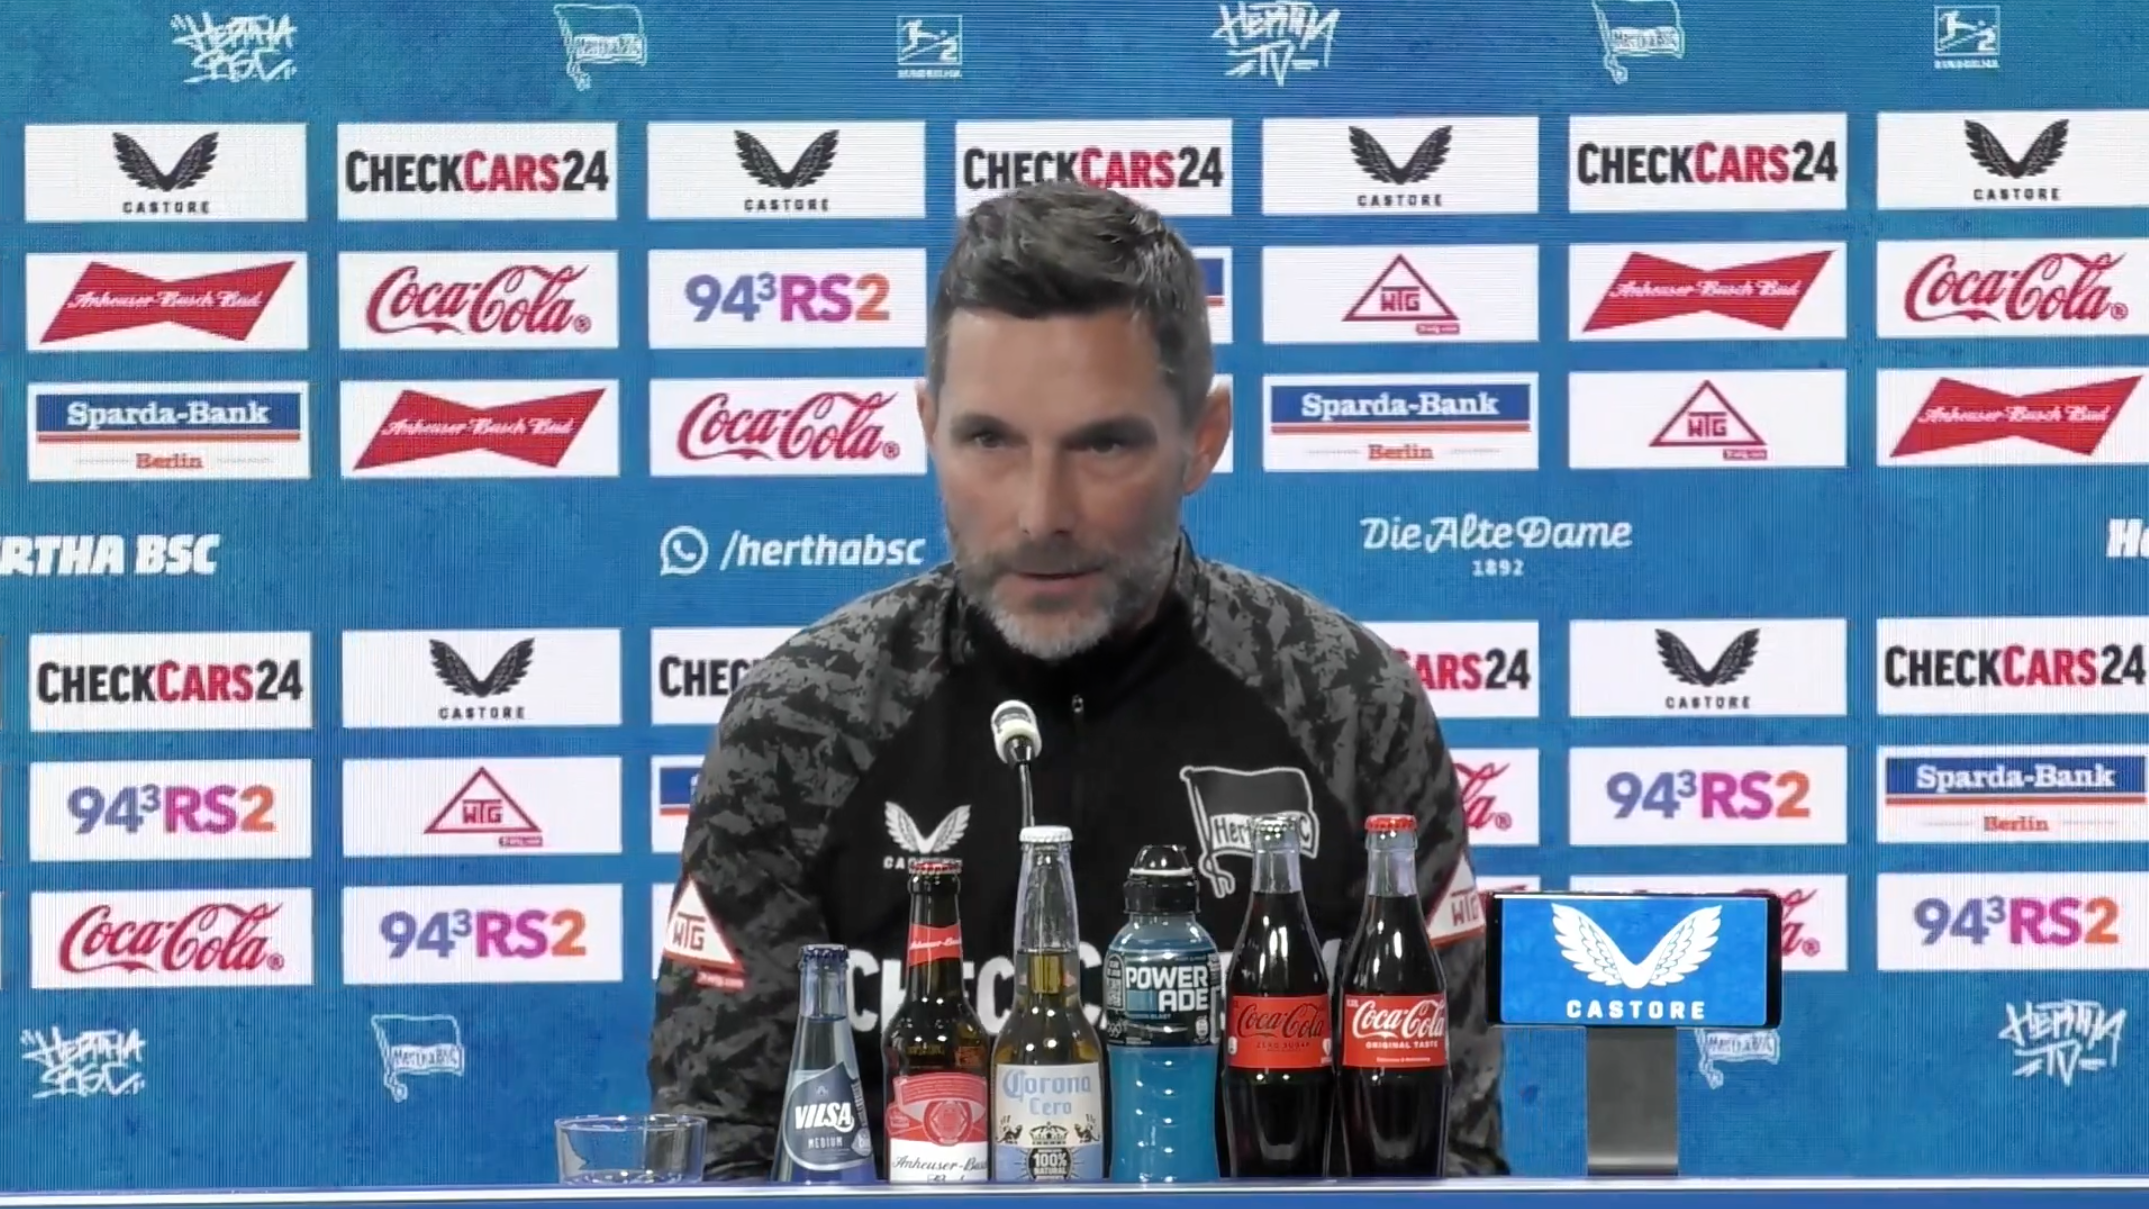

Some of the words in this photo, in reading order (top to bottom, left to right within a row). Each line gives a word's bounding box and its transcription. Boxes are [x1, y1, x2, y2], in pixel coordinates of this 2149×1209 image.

[346, 149, 609, 193] CHECKCARS24
[964, 146, 1223, 190] CHECKCARS24
[1578, 140, 1838, 185] CHECKCARS24
[744, 198, 829, 212] CASTORE
[1357, 193, 1442, 207] CASTORE
[1973, 187, 2060, 201] CASTORE
[122, 200, 209, 214] CASTORE
[1381, 286, 1420, 312] WTG
[67, 400, 272, 429] Sparda-Bank
[1301, 391, 1500, 421] Sparda-Bank
[1688, 411, 1727, 438] WTG
[136, 453, 203, 470] Berlin
[1368, 444, 1433, 460] Berlin
[1360, 516, 1422, 550] Die
[1425, 513, 1514, 552] Alte
[1515, 516, 1634, 550] Dame
[0, 534, 124, 576] RTHA
[134, 533, 220, 576] BSC
[719, 530, 927, 571] /herthabsc
[1471, 560, 1525, 576] 1892
[1885, 644, 2146, 688] CHECKCARS24
[37, 659, 303, 704] CHECKCARS24
[438, 706, 524, 720] CASTORE
[1665, 695, 1750, 709] CASTORE
[1916, 763, 2116, 793] Sparda-Bank
[462, 799, 503, 824] WTG
[1983, 816, 2049, 832] Berlin
[672, 911, 706, 951] WTG
[1126, 966, 1208, 989] POWER
[1158, 990, 1210, 1012] ADE
[1566, 999, 1705, 1020] CASTORE
[1236, 1002, 1325, 1039] Coca-Cola
[1352, 999, 1445, 1039] Coca-Cola
[1256, 1041, 1280, 1050] ZERO
[1282, 1041, 1310, 1050] SUGAR
[1365, 1040, 1411, 1049] ORIGINAL
[1413, 1039, 1439, 1049] TASTE
[1003, 1068, 1092, 1101] Corona
[795, 1102, 855, 1132] VILSA
[1029, 1098, 1072, 1115] Cero
[808, 1136, 844, 1150] MEDIUM
[1033, 1153, 1068, 1168] 100%
[1033, 1167, 1068, 1176] NATURAL
